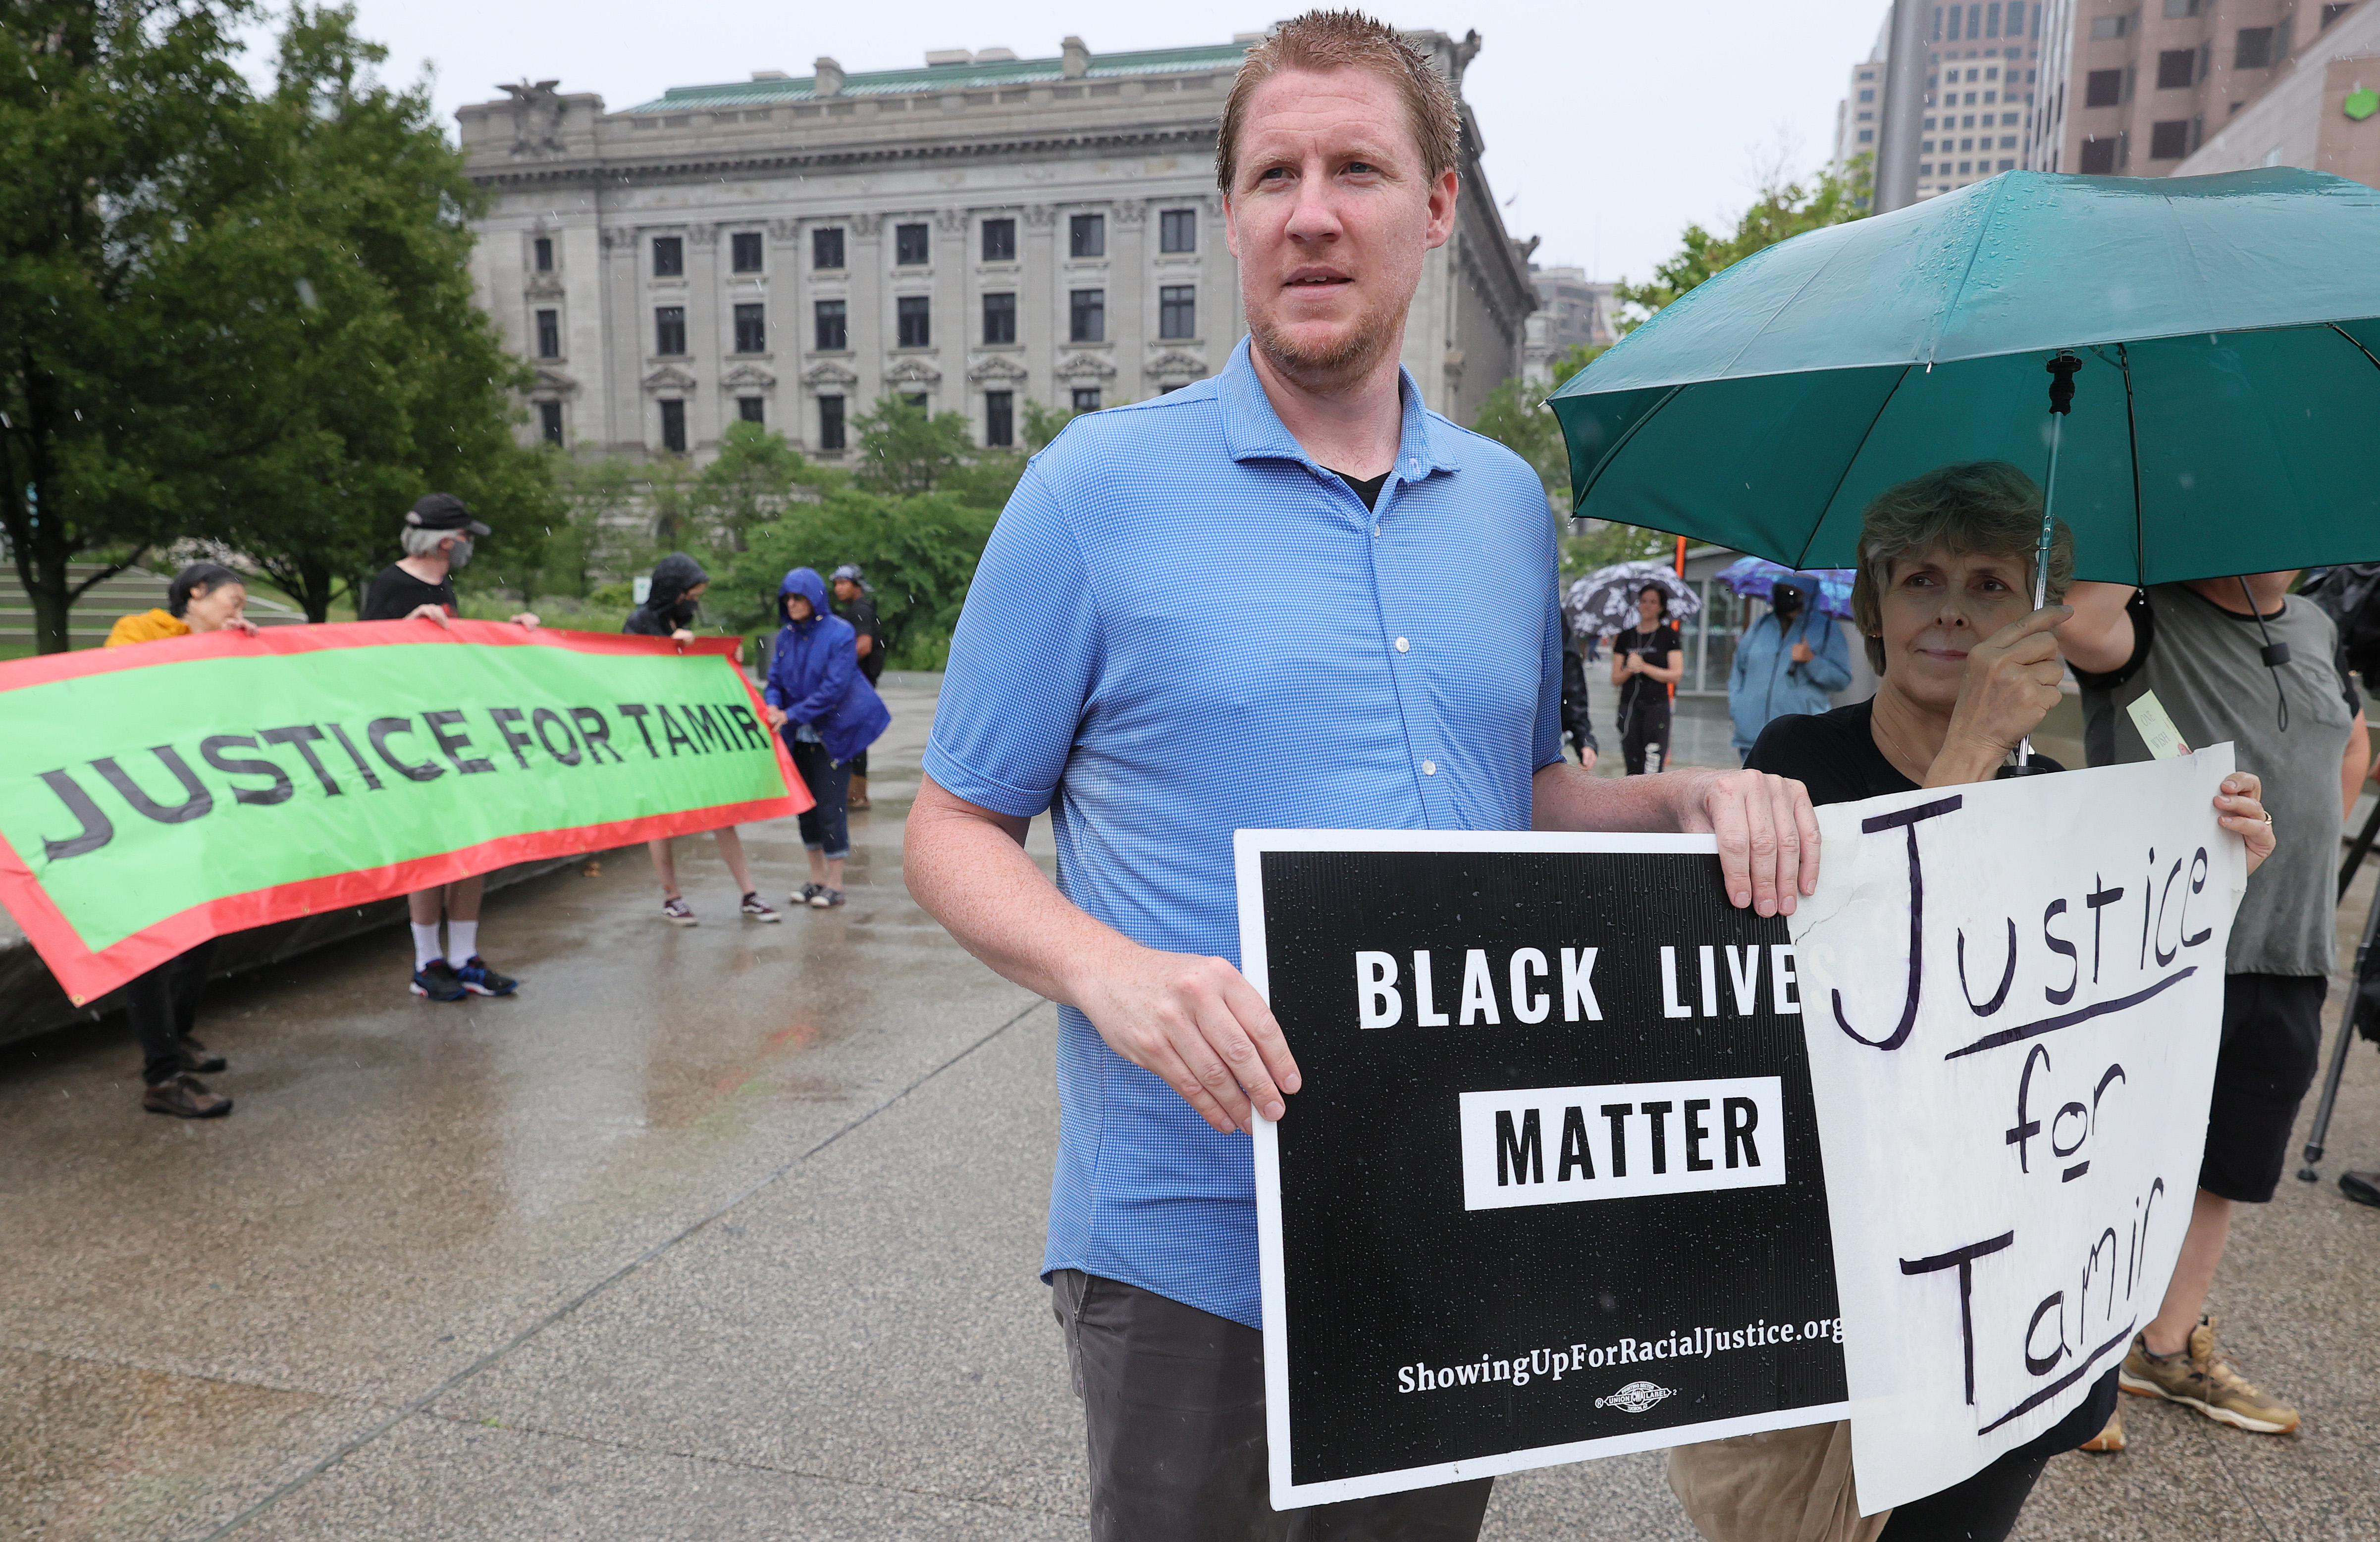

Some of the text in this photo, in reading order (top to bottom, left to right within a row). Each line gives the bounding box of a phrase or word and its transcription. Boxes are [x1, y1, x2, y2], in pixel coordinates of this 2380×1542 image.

[2140, 710, 2156, 726] ONE
[2150, 731, 2171, 749] WISH
[35, 704, 770, 862] JUSTICE FOR TAMIR
[1831, 794, 2212, 1051] Justice
[1355, 947, 1603, 1029] BLACK
[1495, 1097, 1761, 1187] MATTER
[2006, 1043, 2126, 1174] for
[1899, 1177, 2164, 1406] Tamir
[1398, 1317, 1844, 1394] ShowingUpForRacialJustice.org
[1609, 1395, 1630, 1404] UNION
[1645, 1390, 1667, 1399] LABEL
